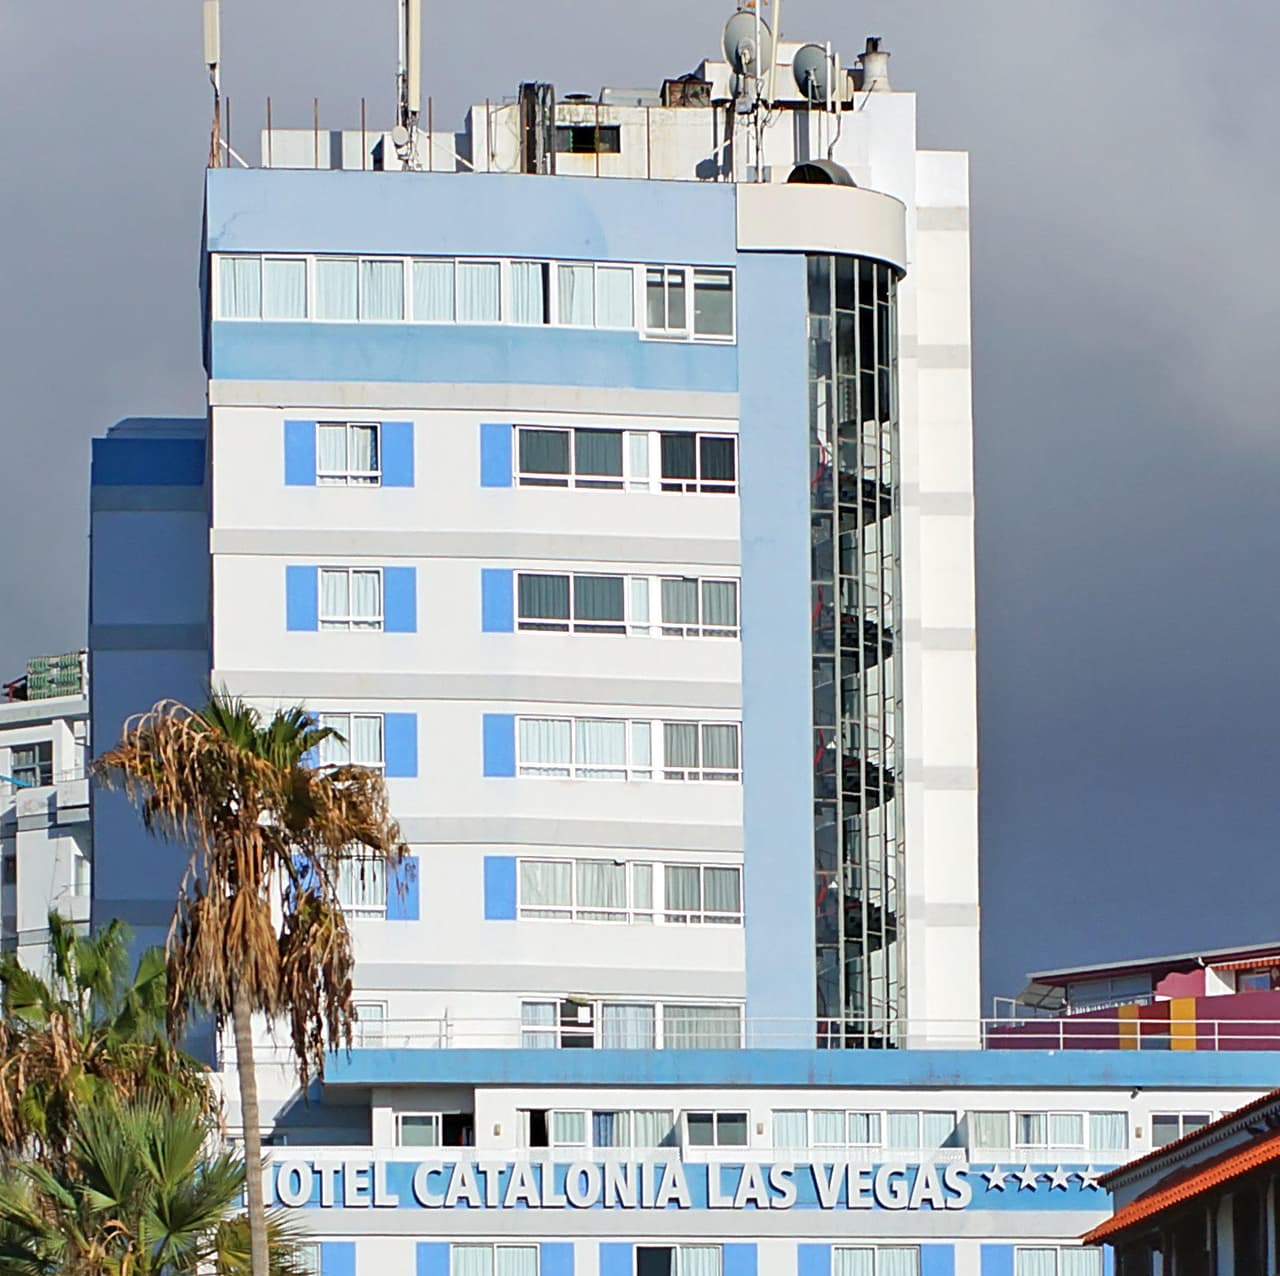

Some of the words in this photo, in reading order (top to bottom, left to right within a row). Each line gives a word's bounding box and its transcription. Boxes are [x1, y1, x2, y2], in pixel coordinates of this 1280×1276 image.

[413, 1160, 692, 1209] CATALONIA
[706, 1162, 798, 1210] LAS
[809, 1162, 974, 1211] VEGAS
